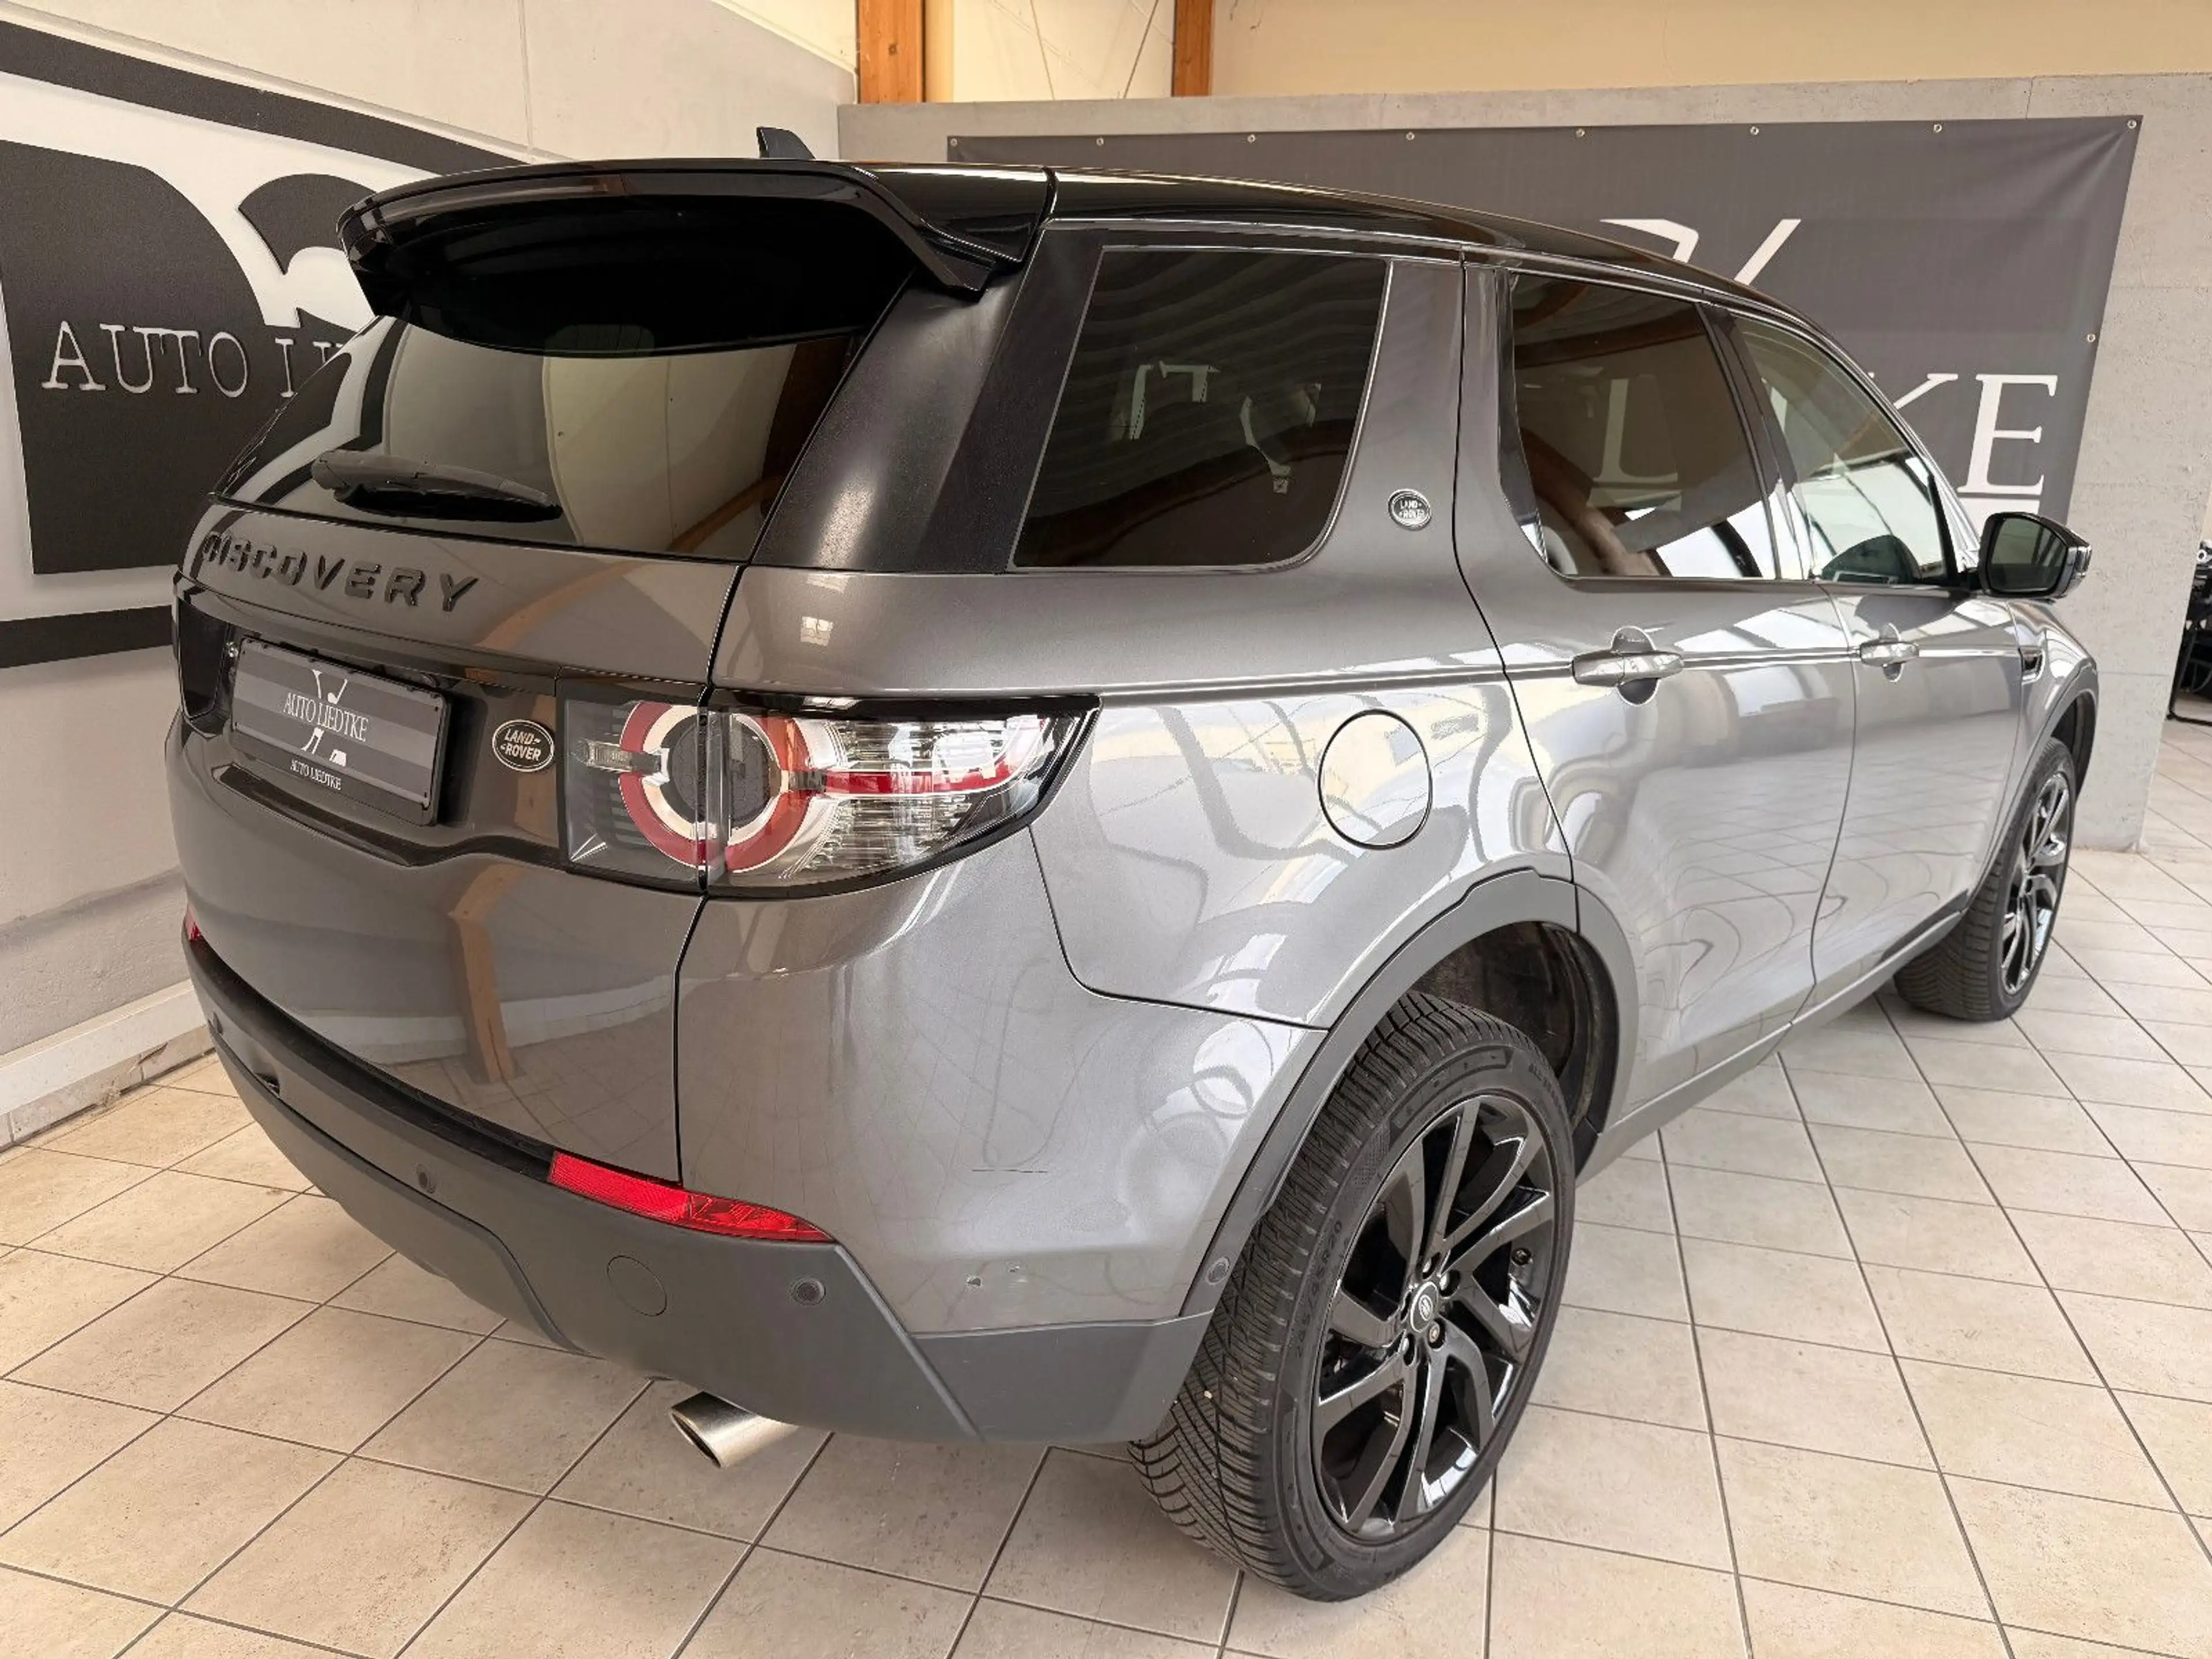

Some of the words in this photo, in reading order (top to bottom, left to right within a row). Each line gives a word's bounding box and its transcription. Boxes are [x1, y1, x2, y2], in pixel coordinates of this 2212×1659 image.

[41, 320, 249, 398] AUTO
[202, 531, 479, 612] DISCOVERY
[283, 692, 316, 722] AUTO
[317, 702, 369, 742] LIEDTKE
[504, 728, 535, 745] LAND
[505, 743, 541, 761] ROVER
[290, 758, 309, 777] AUTO
